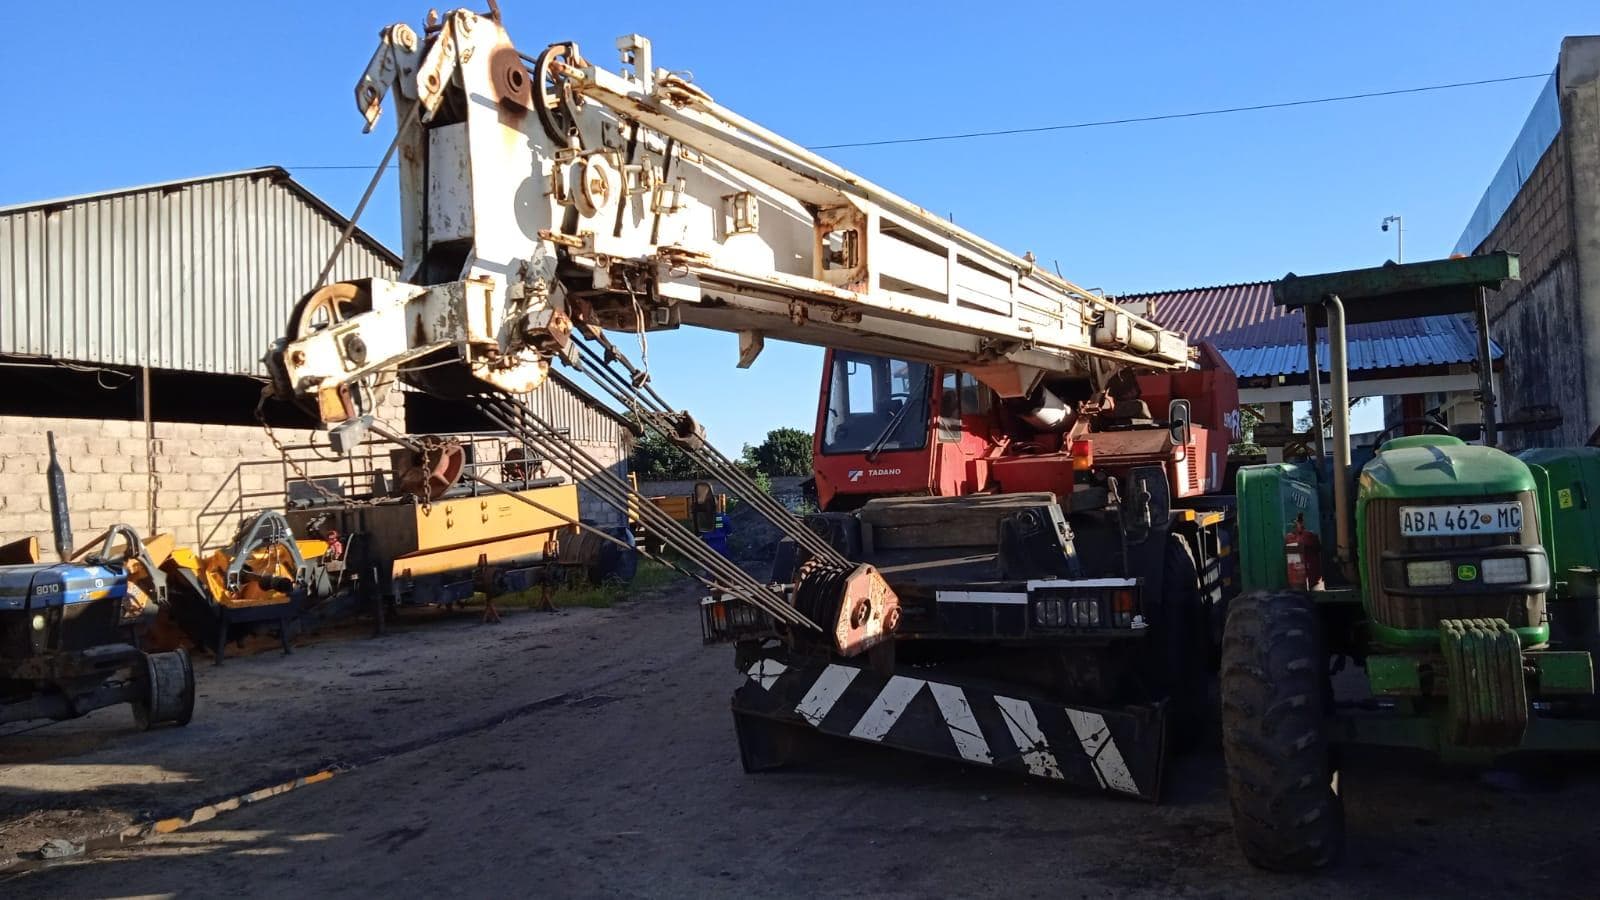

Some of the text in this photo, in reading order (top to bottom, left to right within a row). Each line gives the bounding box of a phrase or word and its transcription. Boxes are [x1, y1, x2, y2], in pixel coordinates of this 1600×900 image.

[868, 469, 901, 477] TADANO
[1404, 507, 1520, 532] ABA 462 MC
